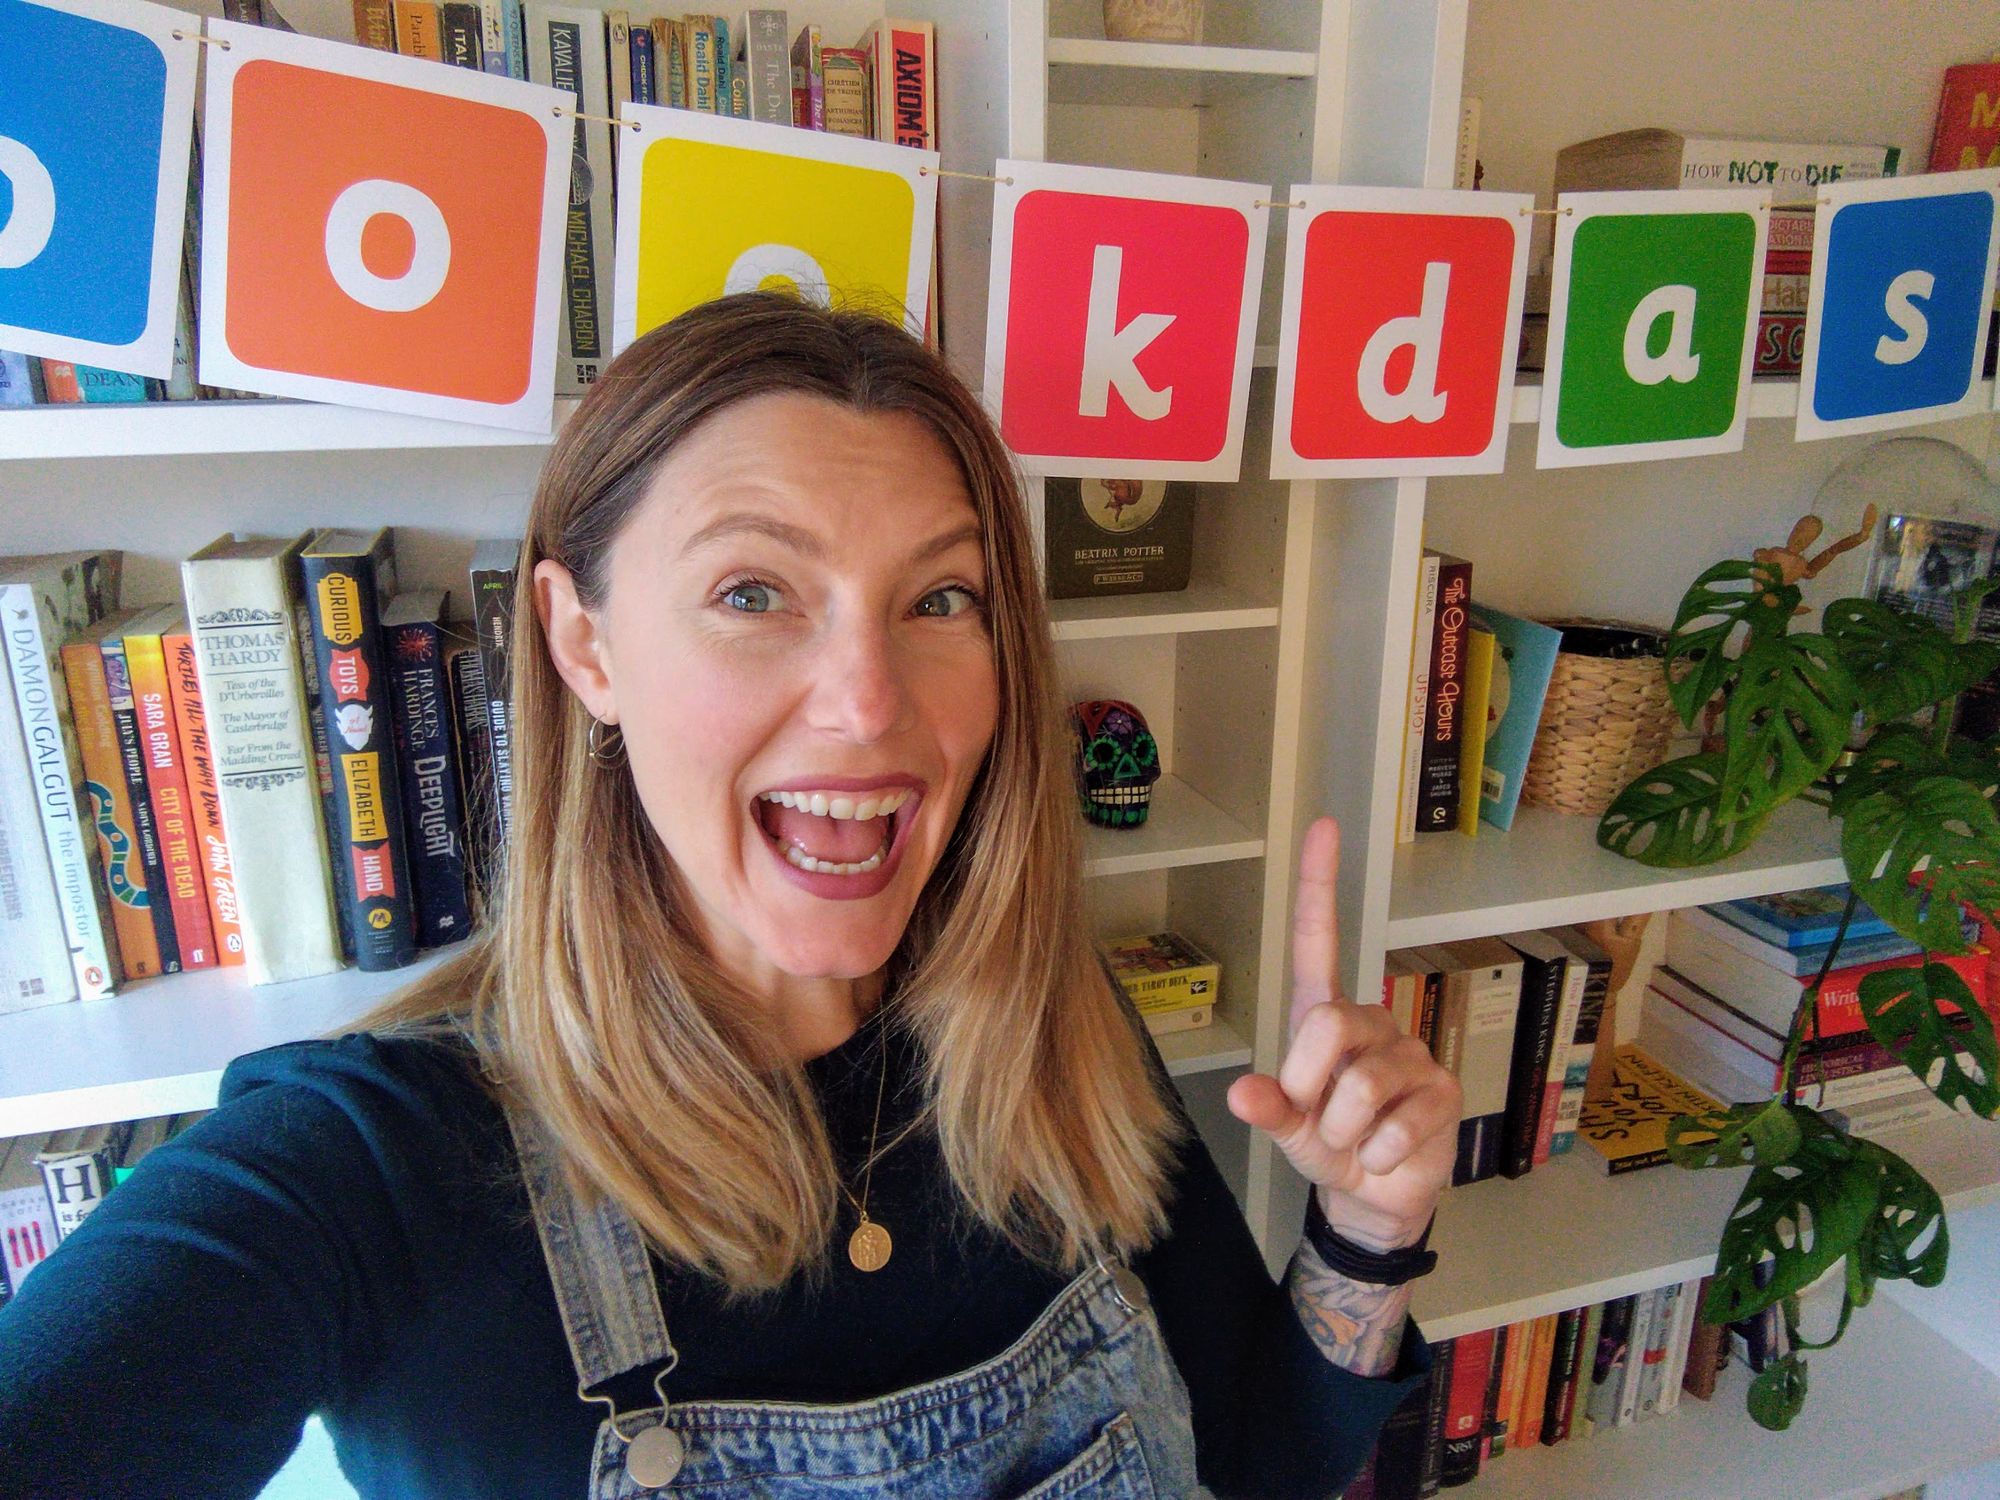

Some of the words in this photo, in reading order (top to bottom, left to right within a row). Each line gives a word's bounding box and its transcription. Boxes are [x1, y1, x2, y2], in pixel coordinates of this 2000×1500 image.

[695, 31, 710, 73] Roald
[715, 37, 726, 65] Roald
[716, 67, 727, 89] Dahl
[765, 61, 780, 90] The
[697, 77, 712, 112] Dahl
[1684, 163, 1725, 179] HOW
[1728, 159, 1780, 185] NOT
[1780, 166, 1802, 183] TO
[567, 211, 591, 285] MICHAEL
[572, 289, 596, 351] CHABON
[83, 371, 141, 387] DEAN
[1074, 547, 1119, 560] BEATRIX
[1123, 545, 1165, 557] POTTER
[1425, 565, 1438, 615] RISCURA
[1443, 577, 1467, 605] The
[327, 575, 353, 643] CURIOUS
[200, 631, 287, 651] THOMAS
[492, 616, 505, 648] HENDRIX
[1440, 606, 1465, 680] Outcast
[176, 642, 200, 694] TURTLES
[208, 649, 281, 668] HARDY
[337, 655, 359, 695] TOYS
[247, 677, 261, 692] of
[260, 677, 277, 689] the
[143, 692, 167, 730] SARA
[183, 698, 205, 725] ALL
[219, 712, 243, 725] The
[243, 711, 277, 727] Mayor
[278, 708, 290, 722] of
[402, 670, 427, 752] HARDINGE
[417, 667, 440, 740] FRANCES
[491, 700, 506, 732] GUIDE
[1436, 681, 1461, 742] Hours
[118, 713, 137, 746] JULY'S
[189, 726, 208, 751] THE
[224, 719, 289, 735] Casterbridge
[495, 734, 508, 747] TO
[150, 731, 174, 769] GRAN
[219, 751, 268, 768] Madding
[267, 750, 302, 764] Crowd
[226, 743, 246, 756] Far
[246, 742, 274, 755] From
[275, 740, 293, 752] the
[123, 746, 143, 785] PEOPLE
[193, 756, 214, 789] WAY
[496, 749, 513, 793] SLAYING
[159, 787, 182, 816] CITY
[199, 791, 220, 829] DOWN
[351, 758, 377, 838] ELIZABETH
[413, 754, 456, 858] DEEPLIGHT
[58, 830, 74, 858] the
[165, 820, 184, 836] OF
[168, 838, 192, 864] THE
[204, 834, 232, 874] JOHN
[174, 867, 197, 899] DEAD
[361, 854, 385, 893] HAND
[64, 862, 91, 937] impostor
[211, 875, 241, 926] GREEN
[1542, 964, 1560, 1026] STEPHEN
[1535, 1029, 1548, 1064] KING
[51, 1163, 97, 1204] H
[62, 1211, 74, 1222] is
